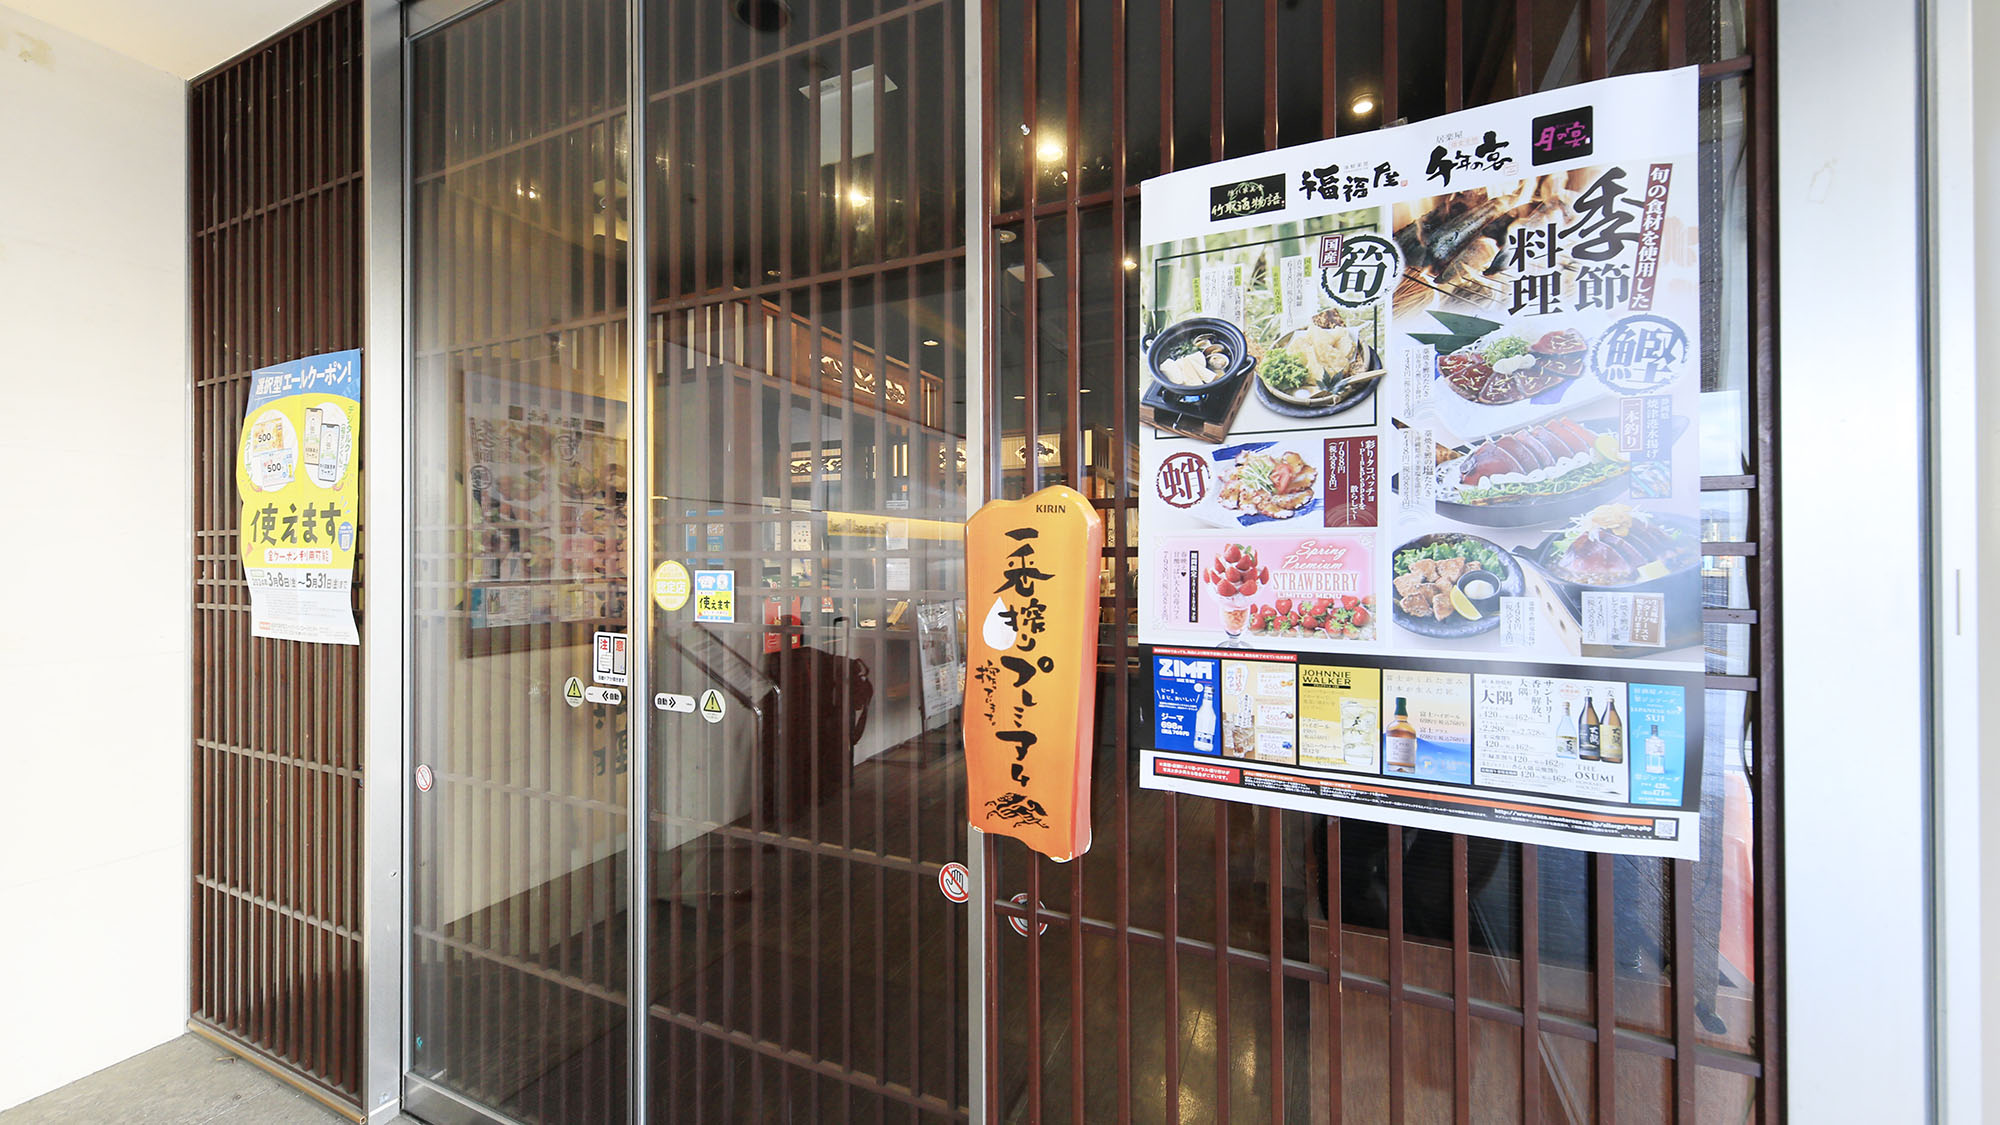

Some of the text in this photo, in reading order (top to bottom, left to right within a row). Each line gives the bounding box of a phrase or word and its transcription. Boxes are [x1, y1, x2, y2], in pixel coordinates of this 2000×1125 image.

[1534, 121, 1588, 151] 月の宴
[1426, 130, 1513, 187] 千年の宴
[1558, 166, 1643, 312] 季節
[1631, 167, 1670, 310] 旬の食材を使用した
[1322, 238, 1341, 266] 国産
[1333, 245, 1388, 298] 筍
[1507, 222, 1563, 317] 料理
[1604, 320, 1678, 386] 鰹
[1624, 402, 1640, 448] 一本釣り
[258, 432, 272, 442] 500
[267, 463, 282, 472] 500
[1338, 441, 1346, 474] 798円
[1365, 440, 1375, 502] 彩りタコパッチョ
[1036, 504, 1066, 513] KIRIN
[251, 502, 341, 545] 使えます
[1295, 540, 1347, 560] Spring
[1282, 555, 1343, 570] Premium
[1273, 572, 1358, 592] STRAWBERRY
[700, 596, 730, 610] 使えます
[1158, 658, 1213, 680] ZIMA
[1302, 669, 1351, 679] JOHNNIE
[1302, 677, 1351, 685] WALKER
[609, 693, 620, 701] 自動
[657, 697, 667, 706] 自動
[1481, 689, 1513, 705] 大隅
[1543, 680, 1554, 723] サントリー
[1161, 712, 1184, 722] ジーマ
[1645, 714, 1665, 722] SUI
[1574, 770, 1615, 783] OSUMI
